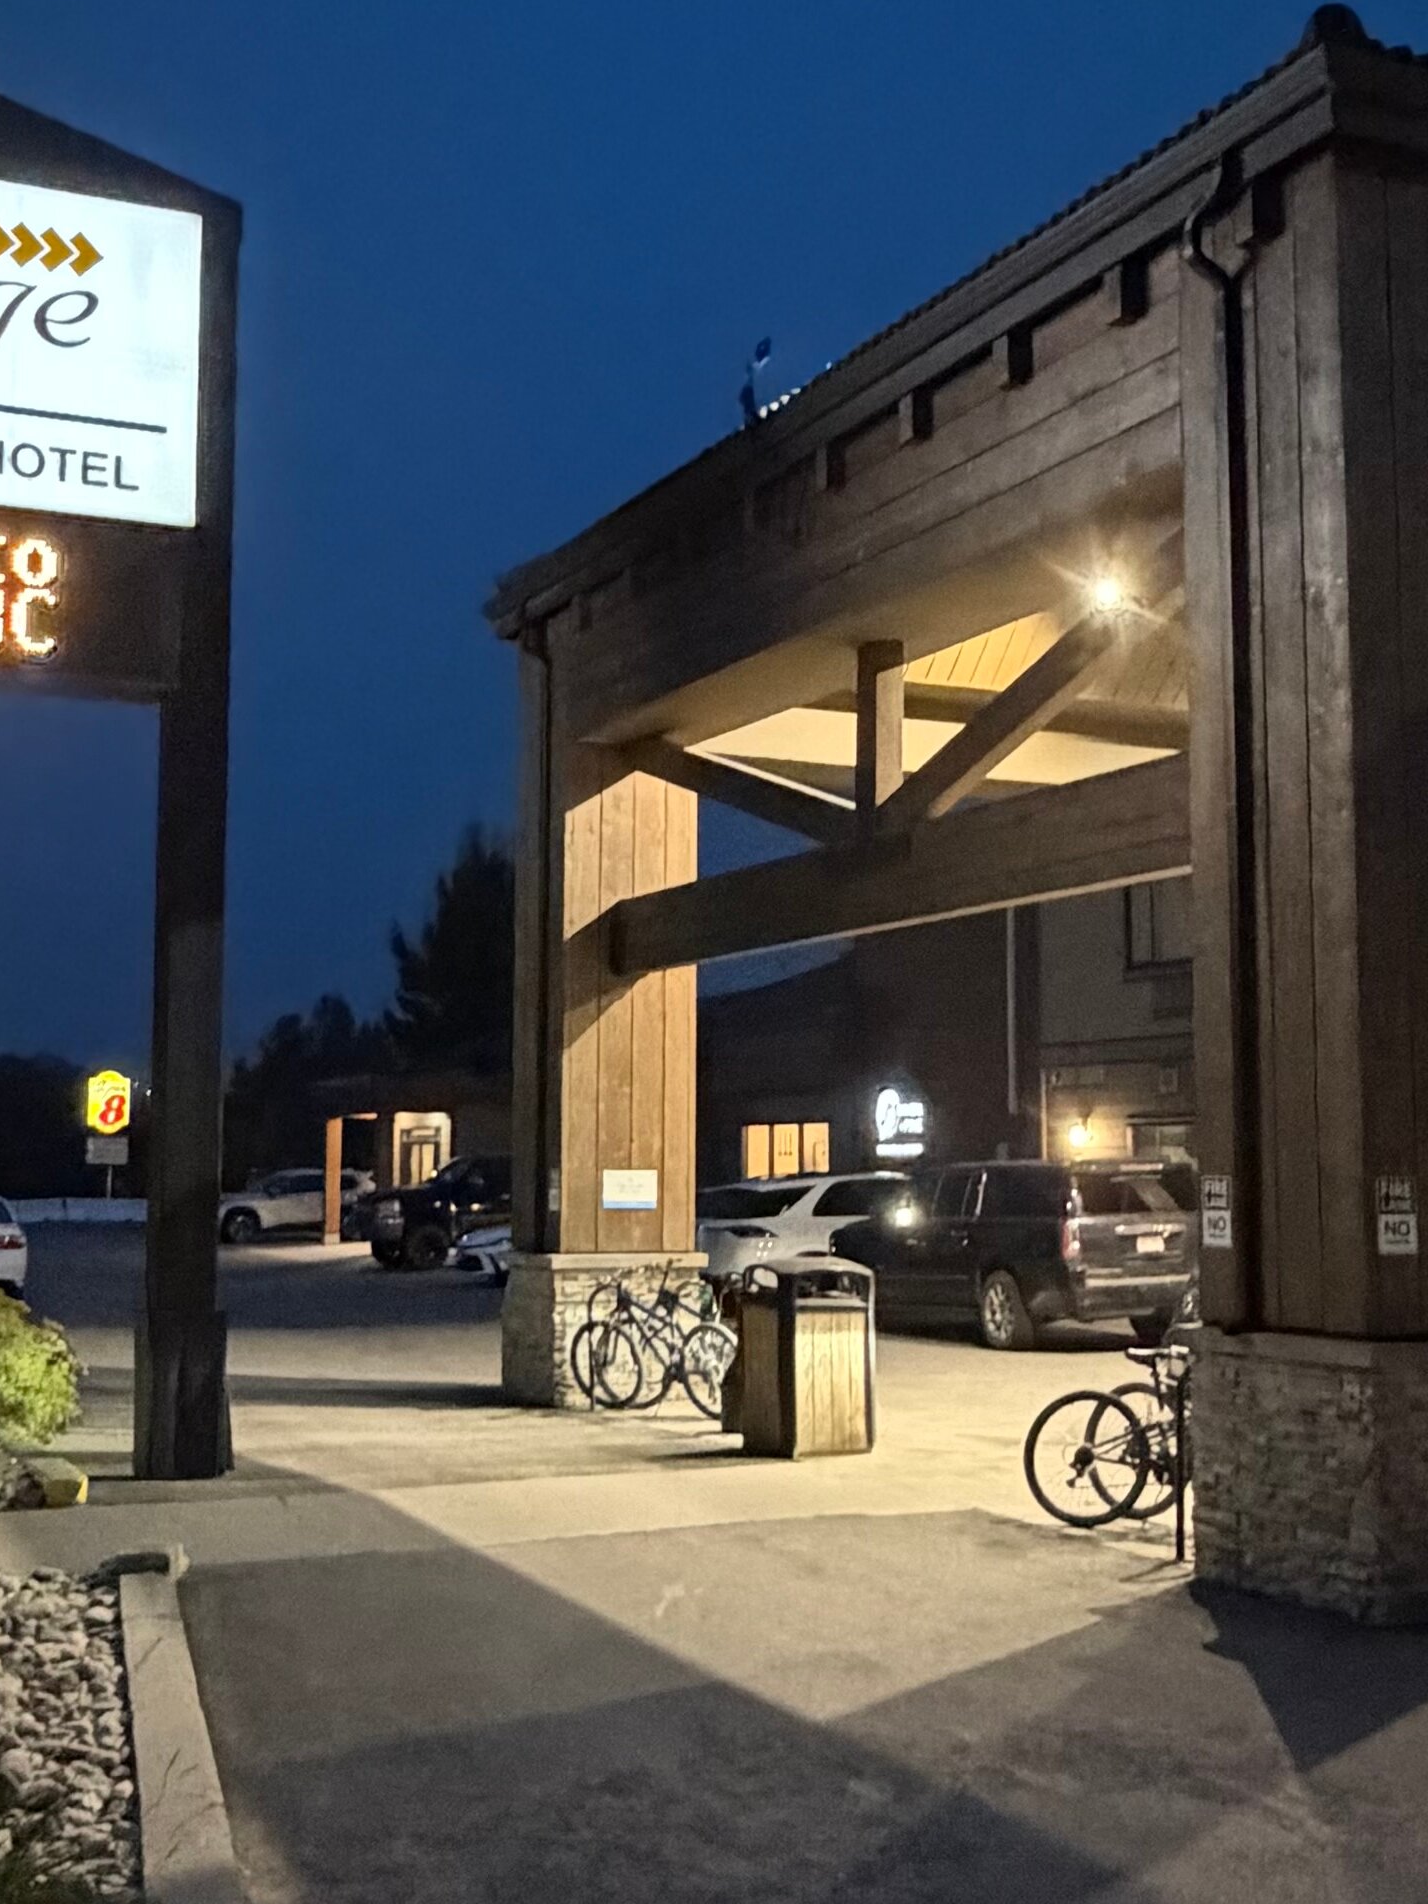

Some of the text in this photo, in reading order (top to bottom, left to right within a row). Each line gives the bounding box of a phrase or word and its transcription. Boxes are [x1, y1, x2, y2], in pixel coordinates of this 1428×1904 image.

[99, 1095, 125, 1125] 8
[1207, 1216, 1227, 1232] NO
[1384, 1221, 1411, 1236] NO
